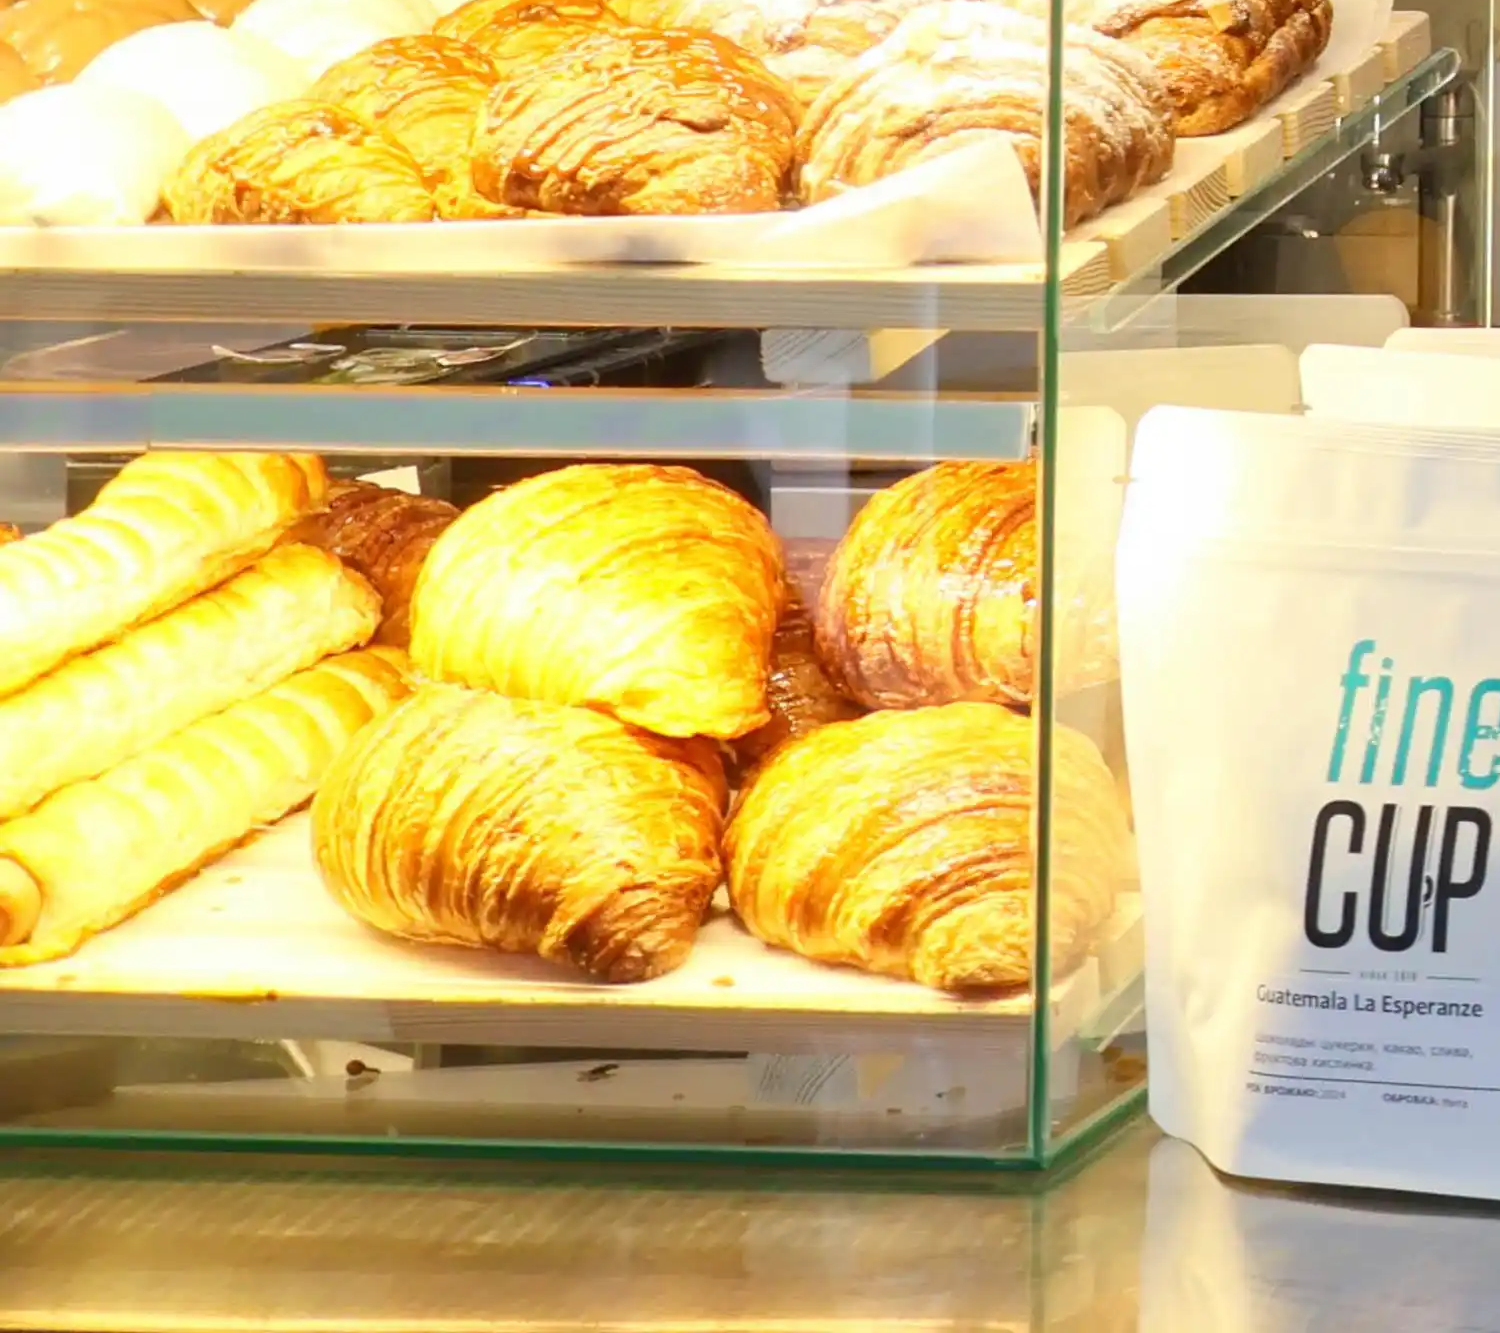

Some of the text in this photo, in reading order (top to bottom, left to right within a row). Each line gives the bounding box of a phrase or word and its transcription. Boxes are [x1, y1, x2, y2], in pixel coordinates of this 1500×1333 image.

[1304, 801, 1492, 953] CUP
[1257, 984, 1483, 1018] Guatemala La Esperanze
